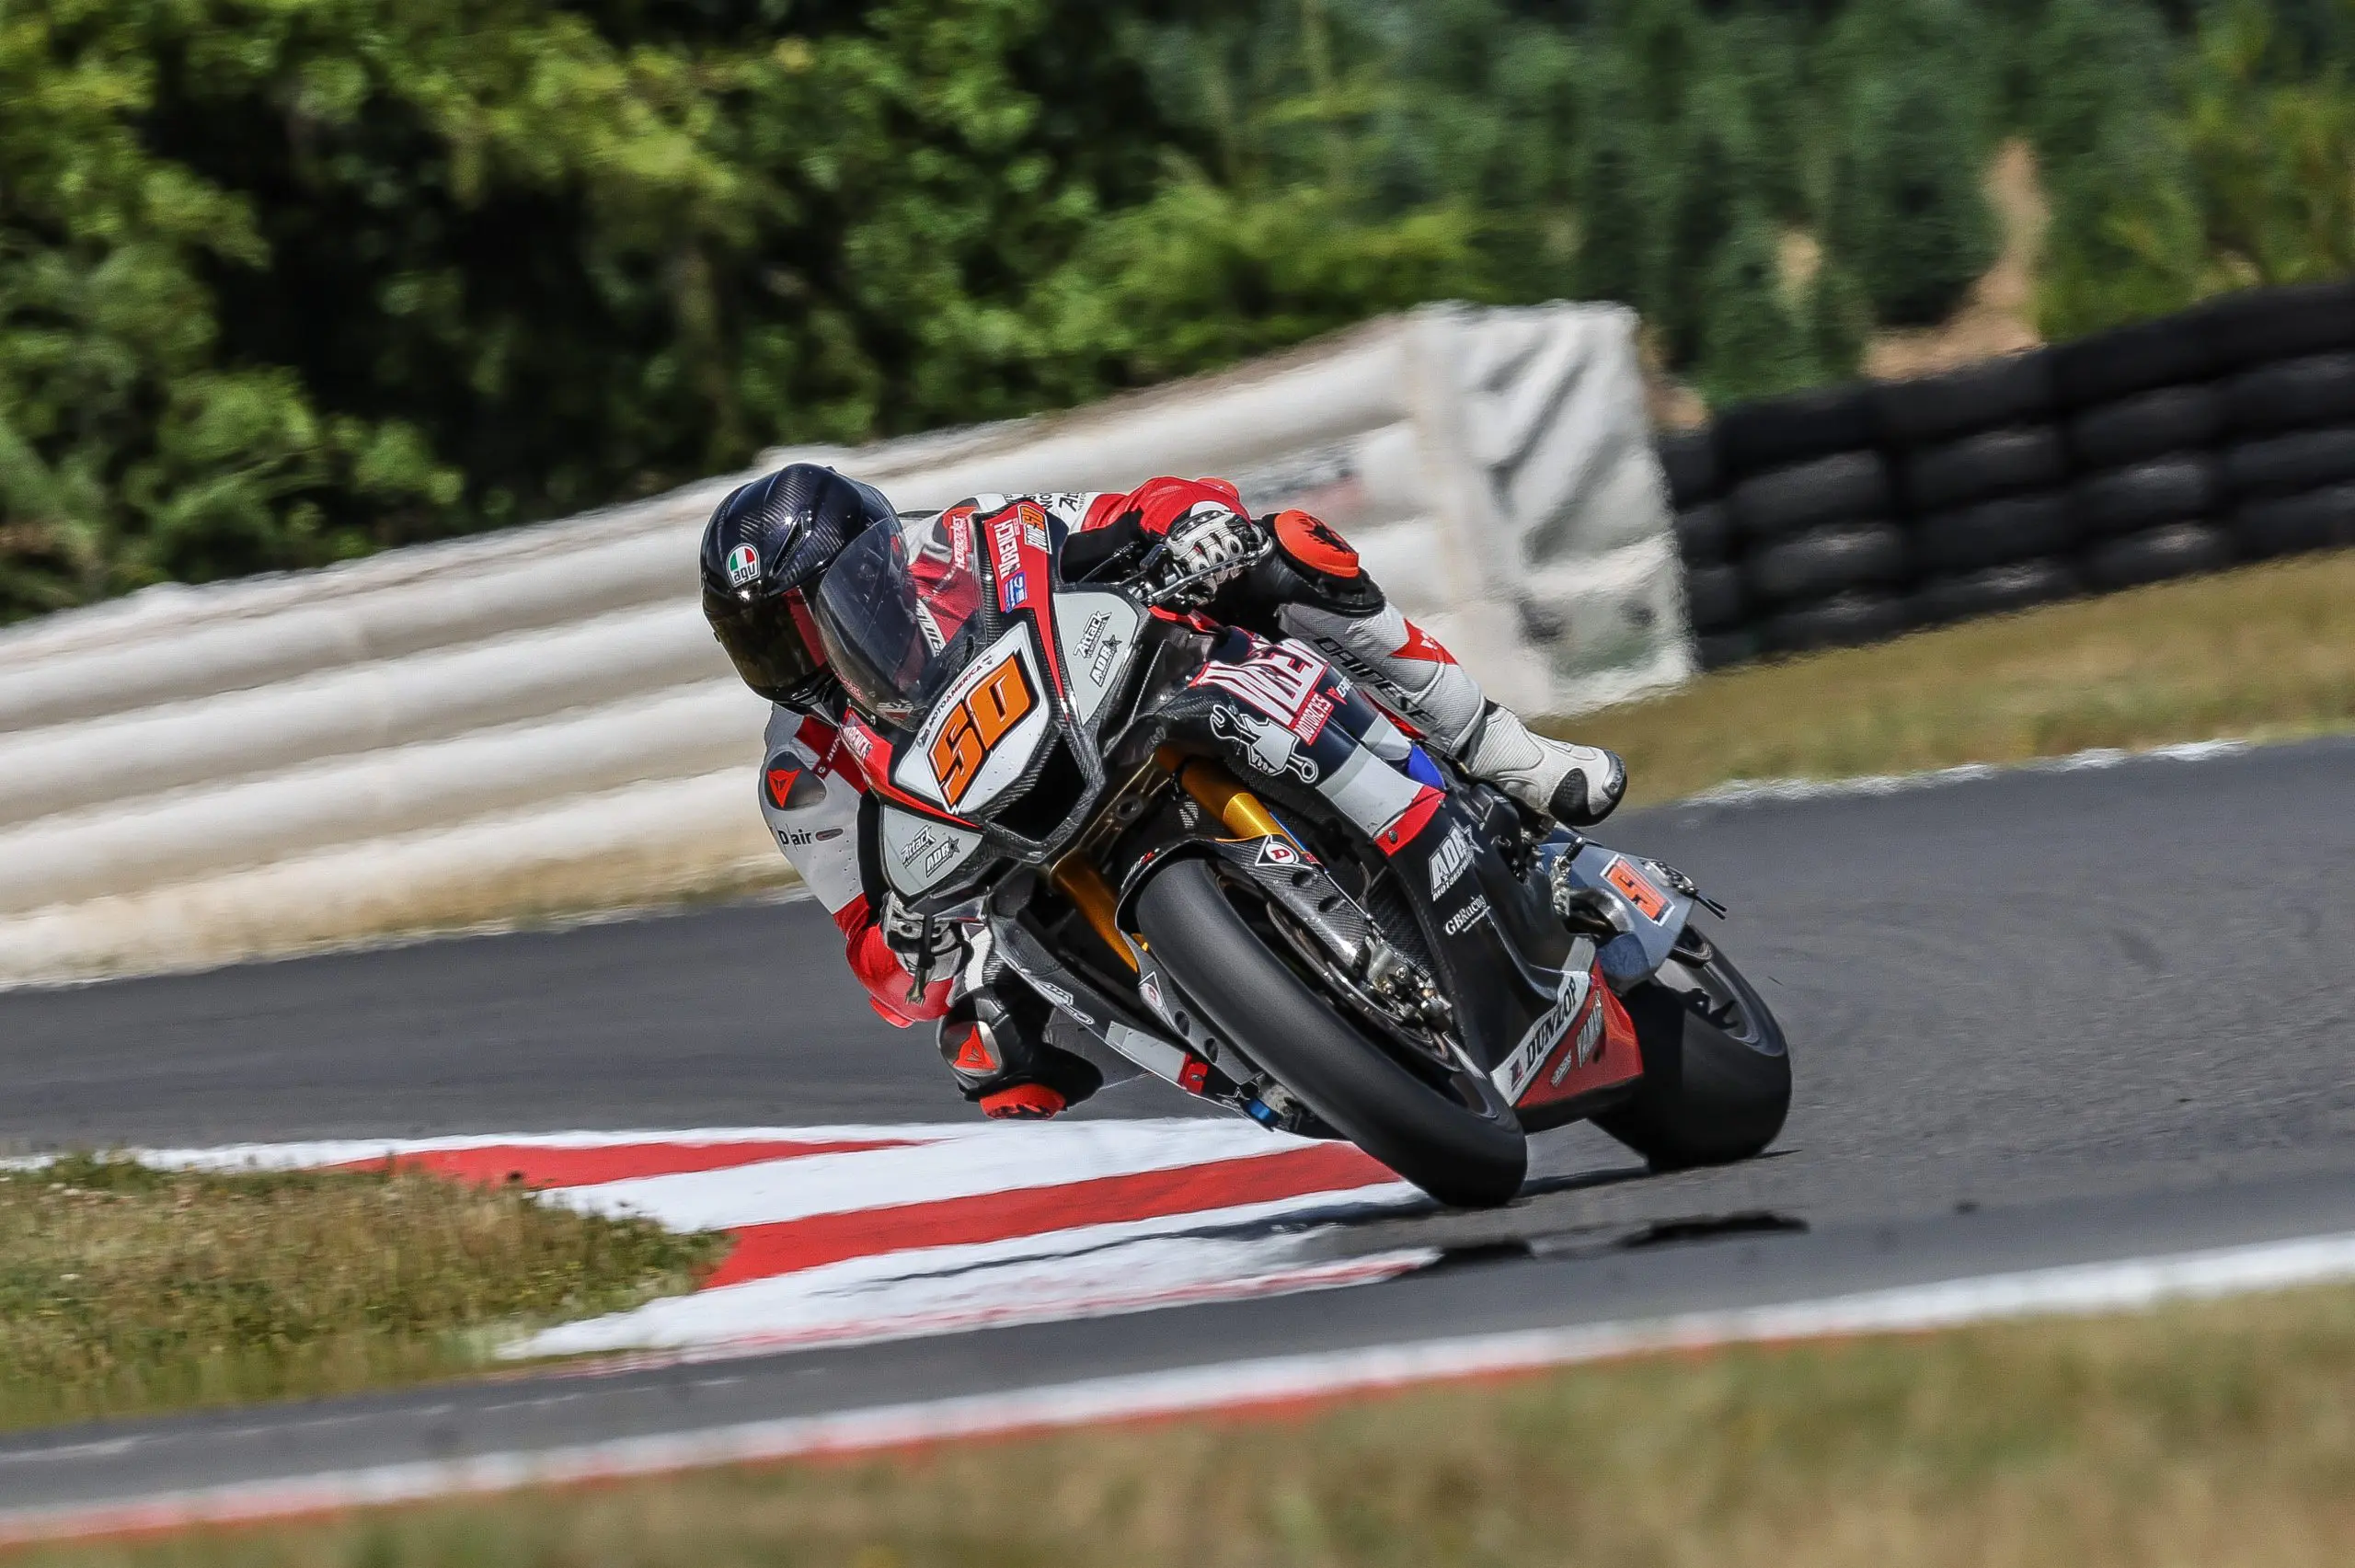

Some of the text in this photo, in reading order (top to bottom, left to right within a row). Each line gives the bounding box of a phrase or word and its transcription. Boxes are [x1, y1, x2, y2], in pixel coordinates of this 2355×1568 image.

[994, 519, 1021, 580] WRENCH
[927, 664, 983, 728] MOTOAMERICA
[929, 654, 1031, 807] 50
[1526, 976, 1577, 1072] DUNLOP
